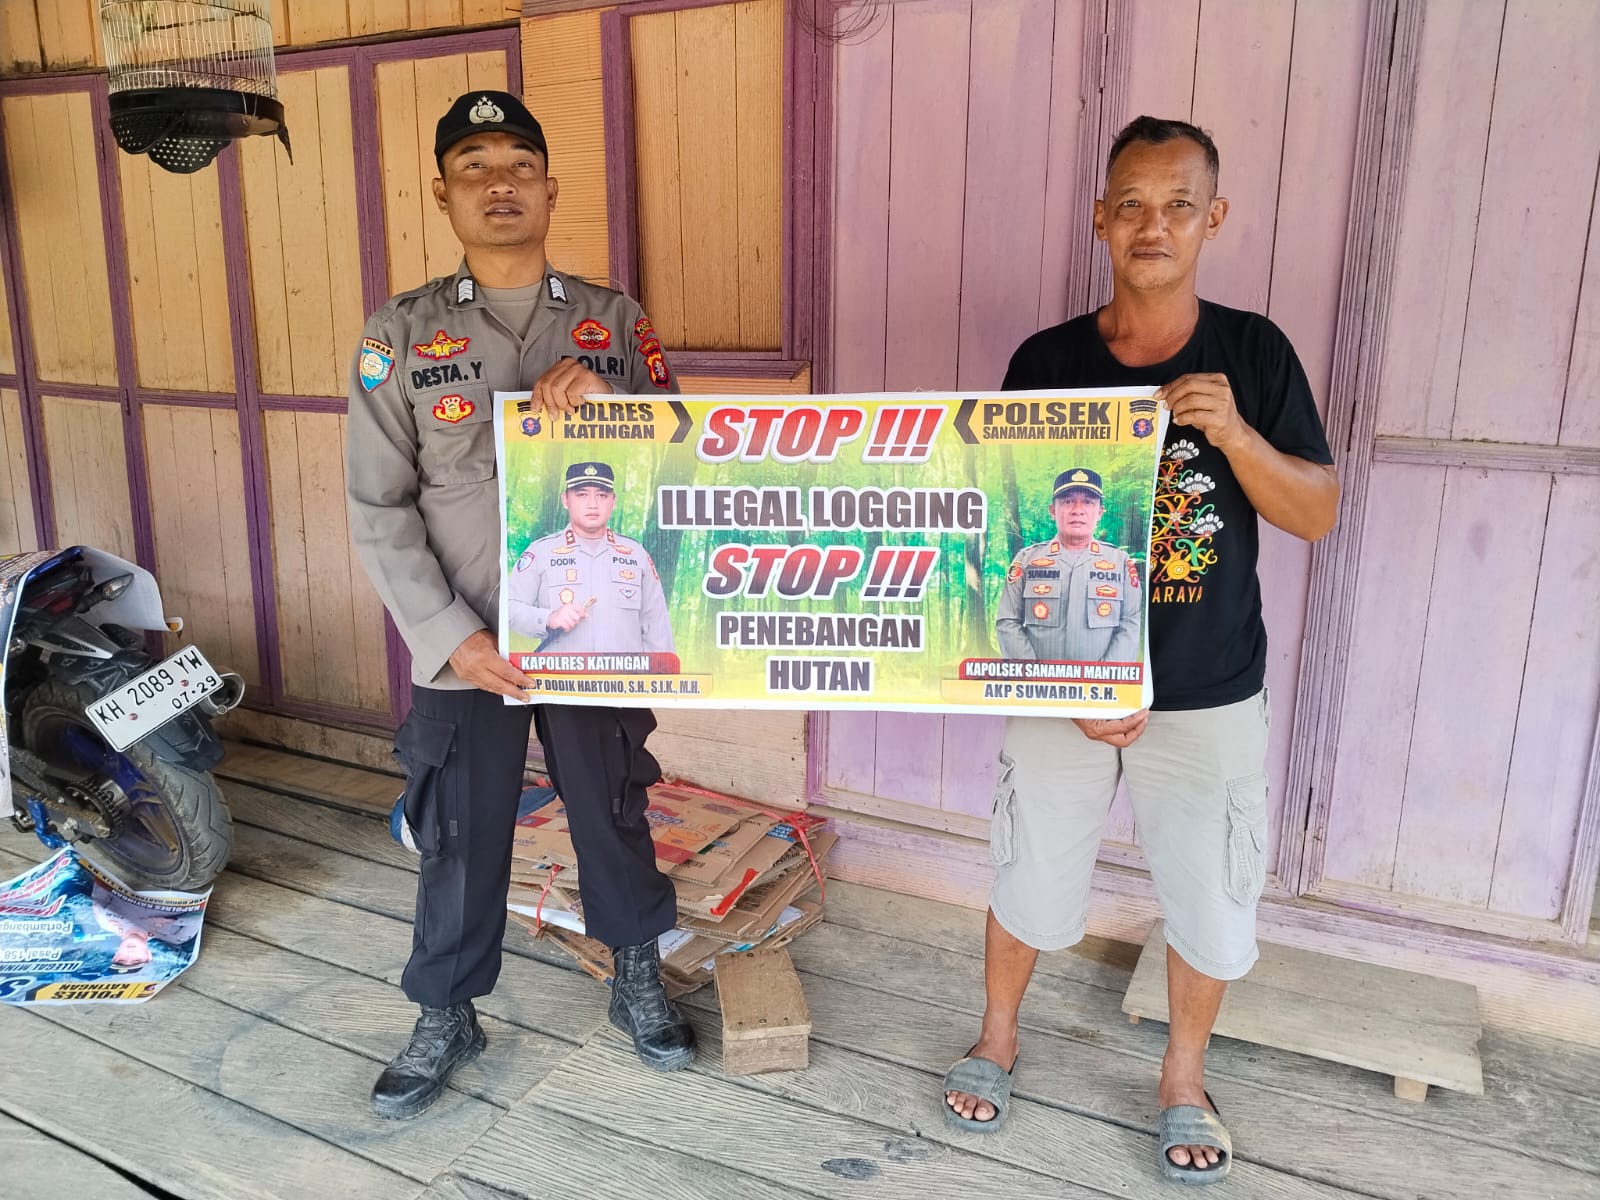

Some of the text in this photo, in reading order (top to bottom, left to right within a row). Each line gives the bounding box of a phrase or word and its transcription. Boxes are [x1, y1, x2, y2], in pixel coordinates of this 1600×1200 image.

[561, 355, 625, 376] OLRI
[983, 402, 1111, 425] POLSEK
[564, 424, 655, 439] KATINGAN
[702, 408, 944, 457] STOP !!!
[983, 426, 1111, 440] SANAMAN MANTIKEI
[662, 490, 983, 529] ILLEGAL LOGGING
[550, 558, 576, 567] DODIK
[612, 556, 638, 566] POLRI
[706, 548, 937, 598] STOP !!!
[1089, 570, 1121, 582] POLRI
[720, 615, 921, 648] PENEBANGAN
[521, 656, 650, 671] KAPOLRES KATINGAN
[965, 662, 1141, 681] KAPOLSEK SANAMAN MANTIKEI
[769, 659, 870, 692] HUTAN
[95, 650, 202, 725] KH 2089 YW
[545, 680, 576, 693] DODIK
[578, 680, 627, 694] HARTONO,
[628, 681, 649, 694] S.H.,
[680, 682, 700, 694] M.H.
[984, 683, 1117, 701] AKP SUWARDI, S.H.
[112, 889, 201, 912] KAPOLRES KATINGAN
[26, 949, 60, 960] Pasal
[31, 962, 80, 971] ILLEGAL
[51, 990, 125, 1000] POLRES
